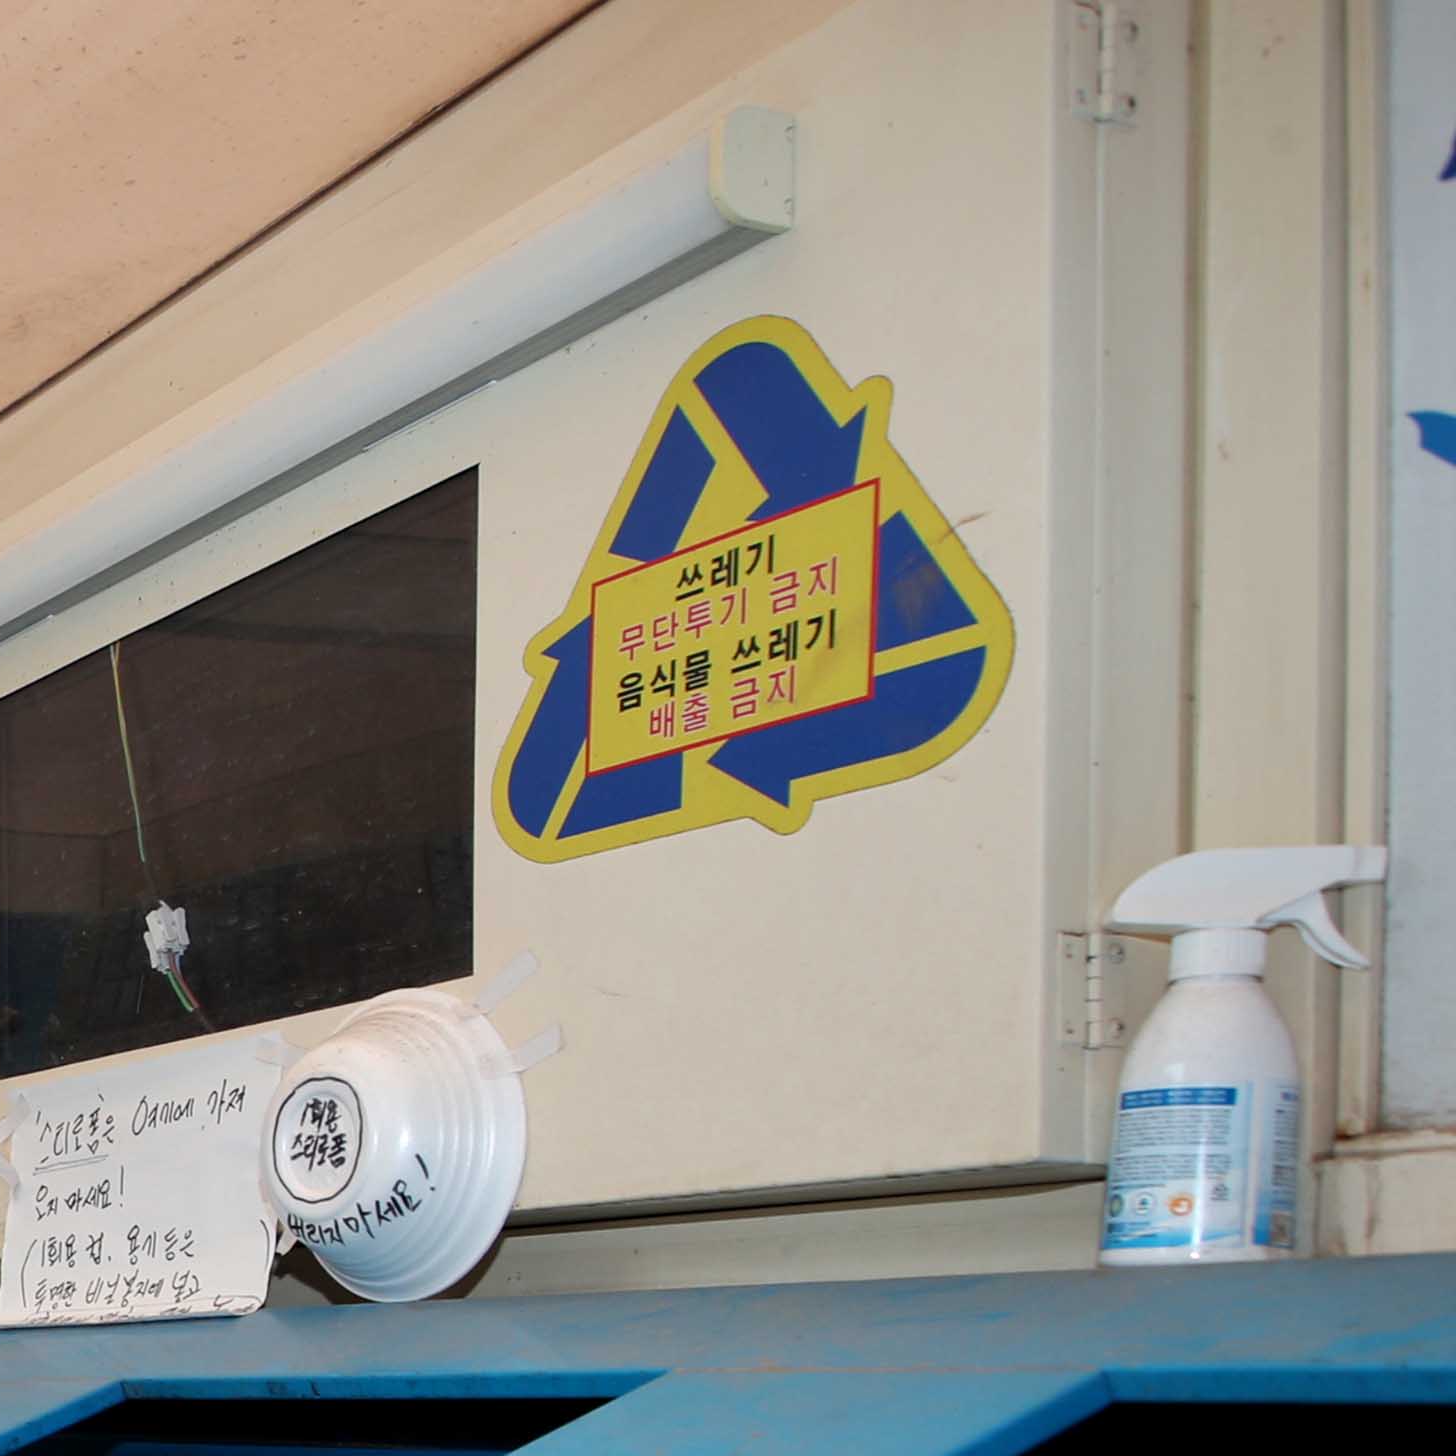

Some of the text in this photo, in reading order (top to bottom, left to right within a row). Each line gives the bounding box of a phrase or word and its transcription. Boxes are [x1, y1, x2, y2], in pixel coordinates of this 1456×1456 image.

[675, 534, 775, 601] 쓰레기
[619, 556, 838, 661] 무단투기 금지
[617, 609, 836, 713] 음식물 쓰레기
[649, 665, 795, 738] 배출 금지
[132, 1096, 194, 1135] 여기에
[207, 1079, 246, 1124] 가져
[36, 1185, 58, 1220] 오지
[288, 1213, 345, 1246] 버리지
